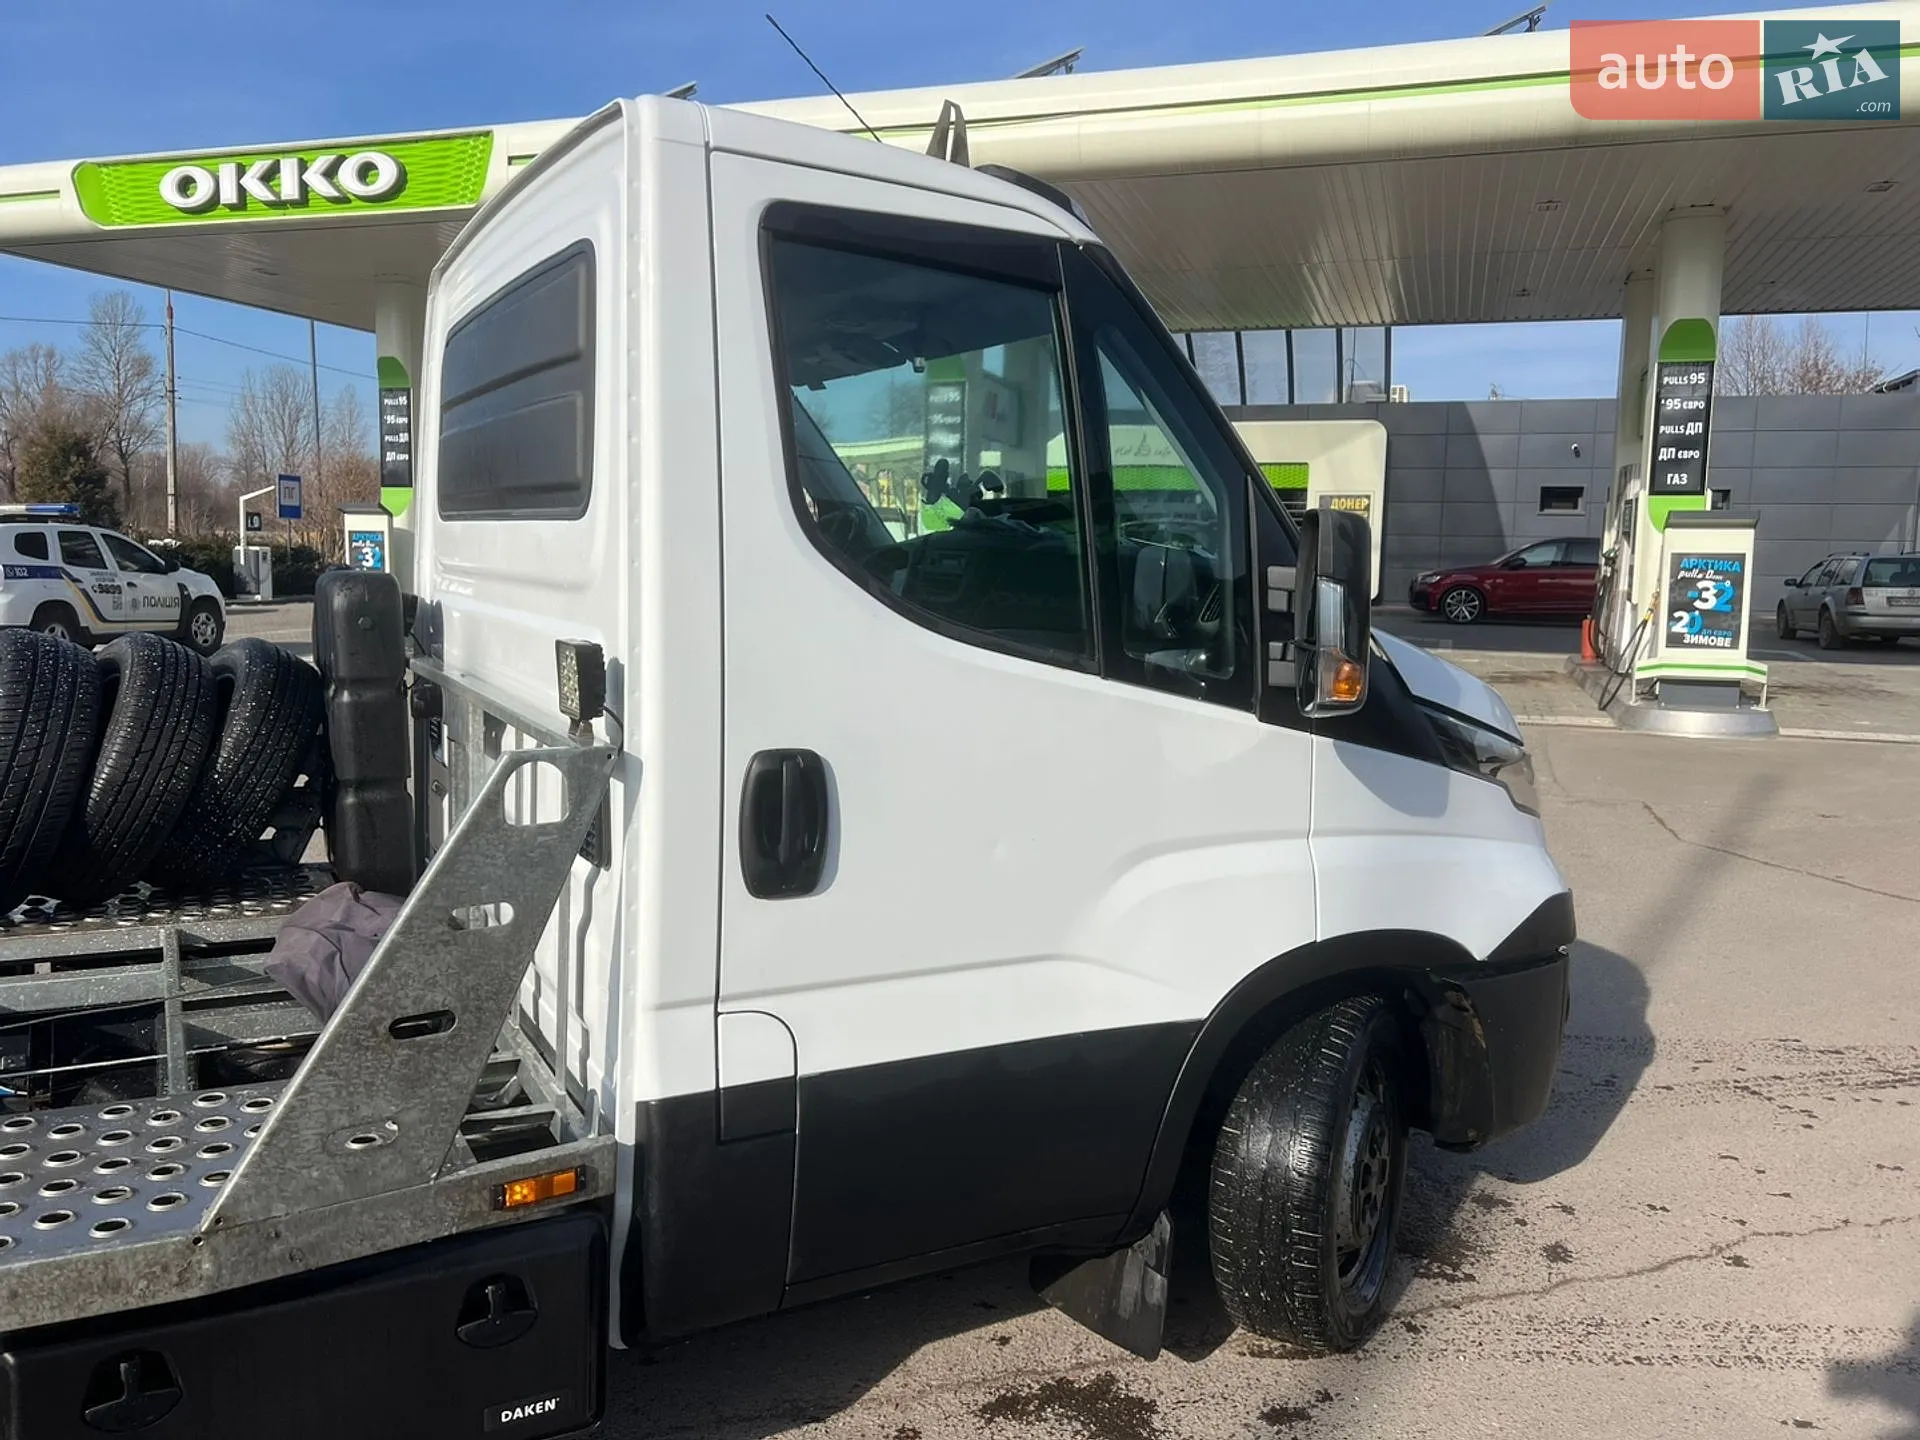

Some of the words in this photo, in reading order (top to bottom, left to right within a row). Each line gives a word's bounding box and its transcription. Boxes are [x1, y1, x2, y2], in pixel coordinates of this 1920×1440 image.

[158, 150, 403, 209] OKKO
[1662, 375, 1689, 385] PULLS
[1689, 372, 1706, 384] 95
[1682, 400, 1705, 410] ЄВРО
[1659, 424, 1685, 434] PULLS
[1685, 421, 1703, 436] ДП
[1658, 447, 1676, 461] ДП
[1677, 450, 1700, 459] ЄВРО
[1666, 473, 1688, 485] ГАЗ
[1330, 497, 1369, 510] ДОНЕР
[1680, 558, 1742, 573] АРКТИКА
[1683, 633, 1732, 648] ЗИМОВЕ
[501, 1398, 557, 1422] DAKEN
